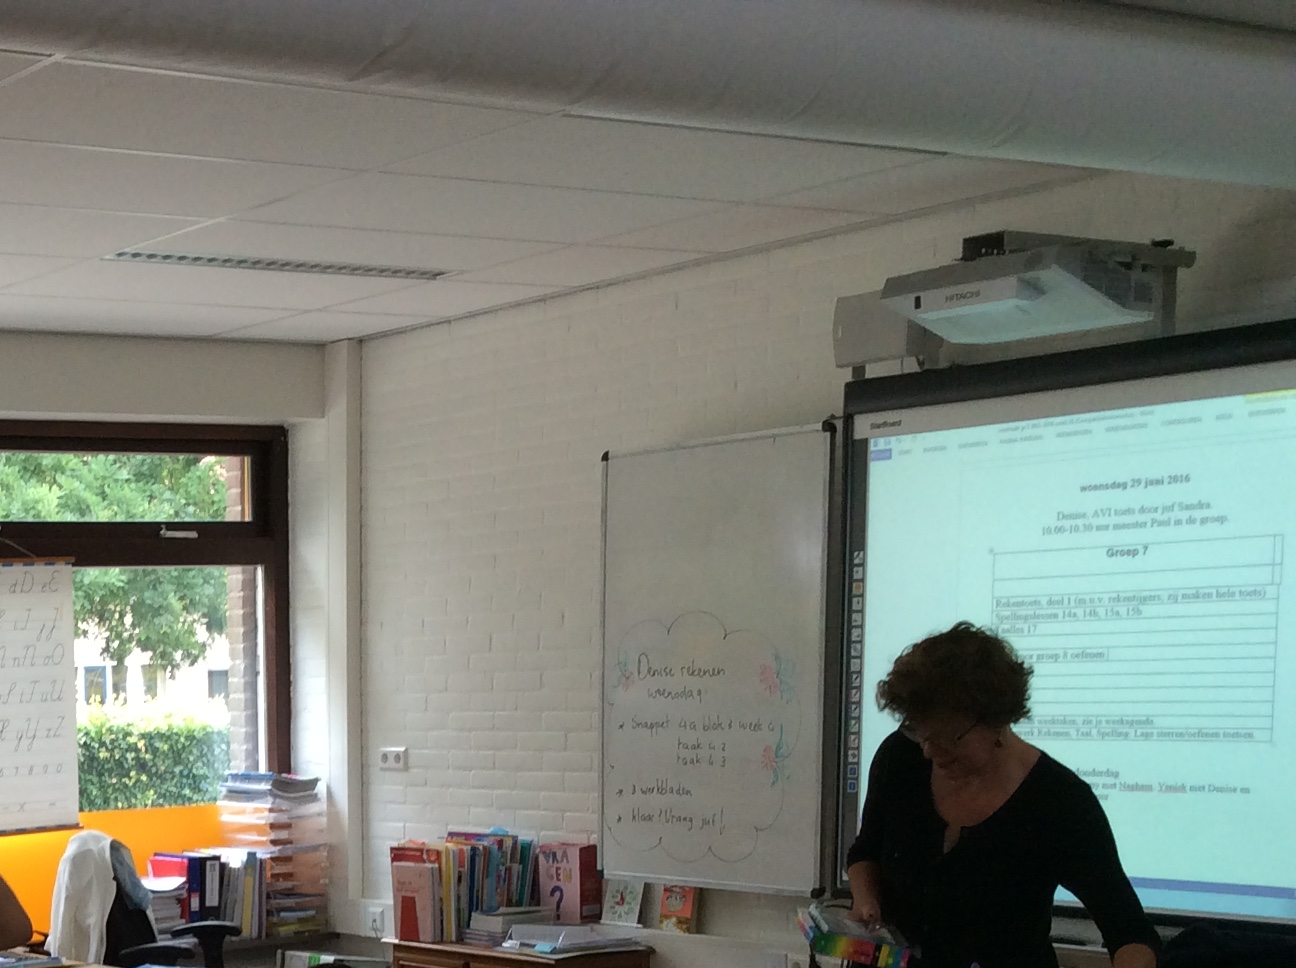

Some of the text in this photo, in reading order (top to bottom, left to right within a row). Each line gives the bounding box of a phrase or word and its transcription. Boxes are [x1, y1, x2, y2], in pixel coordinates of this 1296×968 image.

[945, 289, 981, 303] HITACHI
[1079, 473, 1191, 493] woensdag 29 juni 2016
[1092, 507, 1112, 519] AVI
[1114, 505, 1136, 517] toets
[1138, 503, 1159, 515] door
[1161, 501, 1175, 516] juf
[1112, 518, 1148, 531] meester
[1150, 516, 1171, 529] Paul
[1173, 515, 1184, 527] in
[1185, 514, 1197, 526] de
[1106, 545, 1150, 559] Groep 7
[1046, 596, 1064, 606] deel
[1181, 589, 1214, 601] maken
[1216, 588, 1237, 599] hele
[1027, 624, 1037, 634] 17
[1035, 652, 1060, 663] groep
[1070, 649, 1105, 660] oefenen
[637, 651, 726, 681] Denise rekenen
[631, 713, 671, 738] Snappet
[701, 714, 725, 733] blok
[738, 715, 763, 732] week
[677, 736, 704, 752] taak
[675, 753, 702, 767] taak
[14, 766, 20, 776] 7
[28, 765, 35, 776] 8
[43, 763, 49, 774] 9
[56, 763, 63, 774] 0
[640, 777, 693, 798] werkbladen
[1189, 785, 1206, 793] met
[1207, 783, 1238, 794] Denise
[1239, 786, 1251, 794] en
[545, 864, 573, 884] GEN
